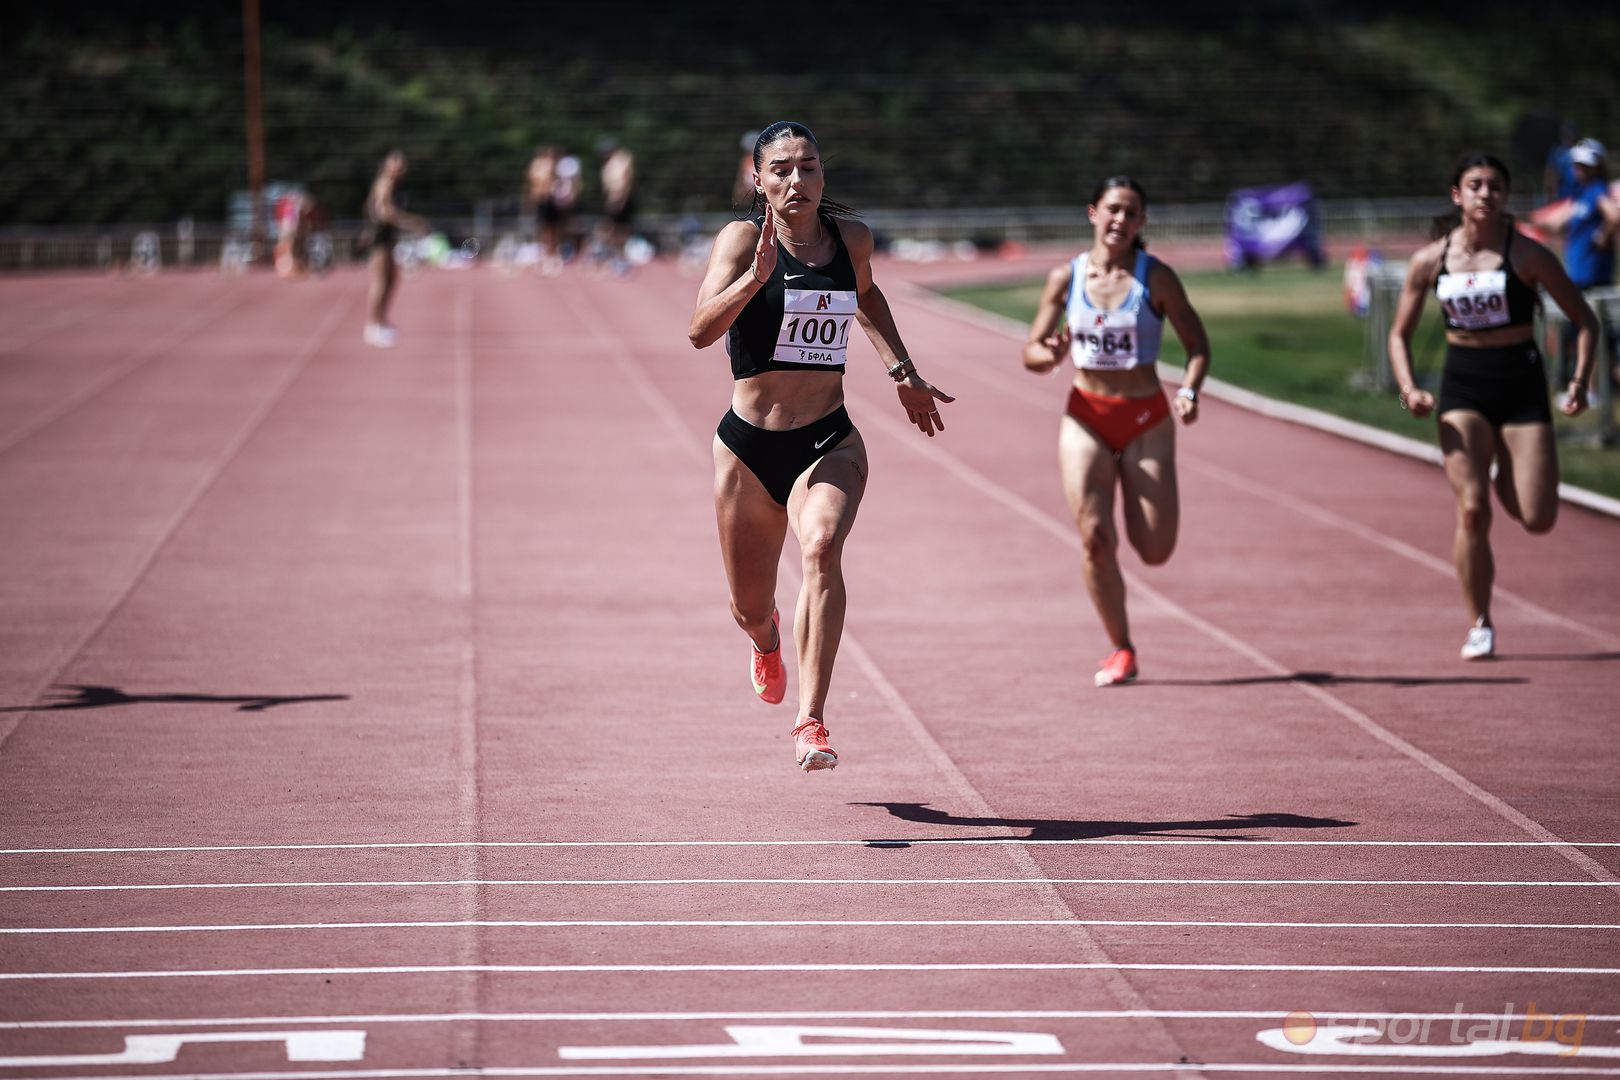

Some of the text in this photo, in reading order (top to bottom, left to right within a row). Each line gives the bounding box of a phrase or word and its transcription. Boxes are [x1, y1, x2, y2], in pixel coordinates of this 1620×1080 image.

[787, 318, 848, 344] 1001
[1075, 332, 1132, 355] 1964
[808, 352, 832, 361] БФЛА
